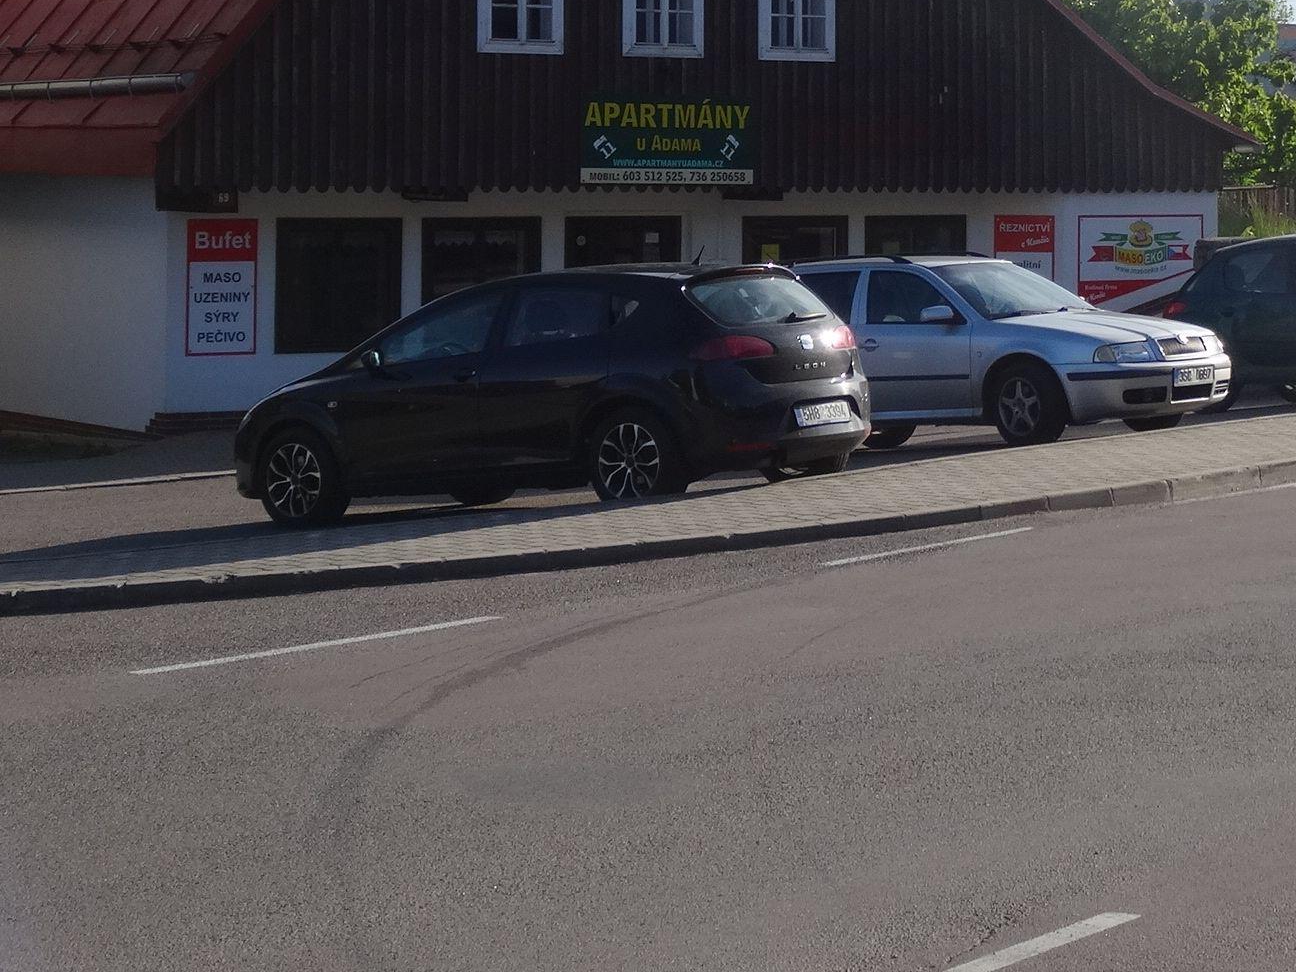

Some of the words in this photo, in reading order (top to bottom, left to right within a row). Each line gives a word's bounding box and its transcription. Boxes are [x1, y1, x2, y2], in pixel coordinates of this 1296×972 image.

[584, 98, 751, 130] APARTMÁNY
[651, 135, 702, 152] ADAMA
[589, 171, 620, 181] MOBIL:
[622, 171, 641, 181] 603
[644, 171, 663, 182] 512
[665, 171, 686, 183] 525,
[689, 172, 708, 182] 736
[710, 172, 746, 182] 250658
[194, 231, 251, 249] Bufet
[203, 272, 242, 283] MASO
[194, 292, 250, 303] UZENINY
[204, 309, 239, 323] SÝRY
[197, 329, 246, 343] PEČIVO
